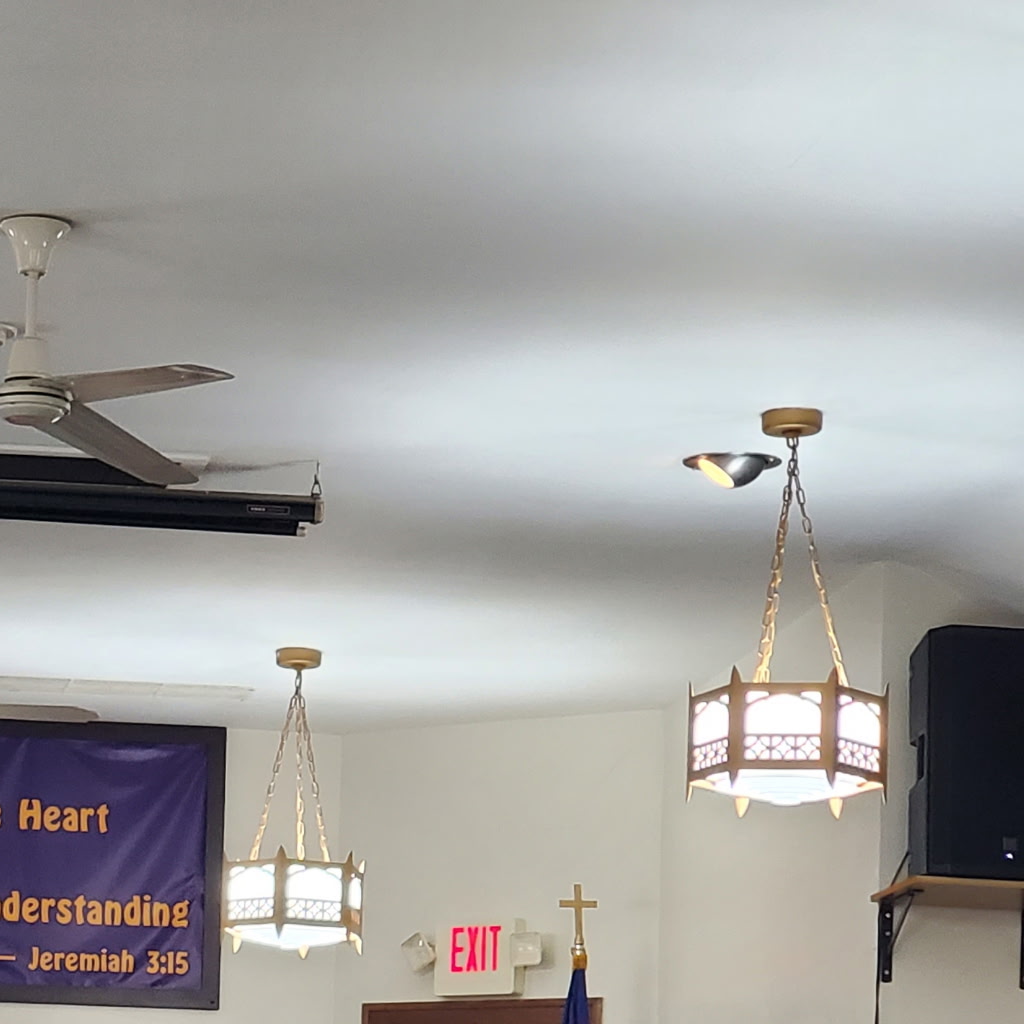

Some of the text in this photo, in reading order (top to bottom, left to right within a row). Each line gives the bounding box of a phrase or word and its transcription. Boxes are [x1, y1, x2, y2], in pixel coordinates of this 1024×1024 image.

[17, 798, 110, 833] Heart
[28, 946, 190, 975] Jeremiah 3:15
[450, 926, 502, 972] EXIT
